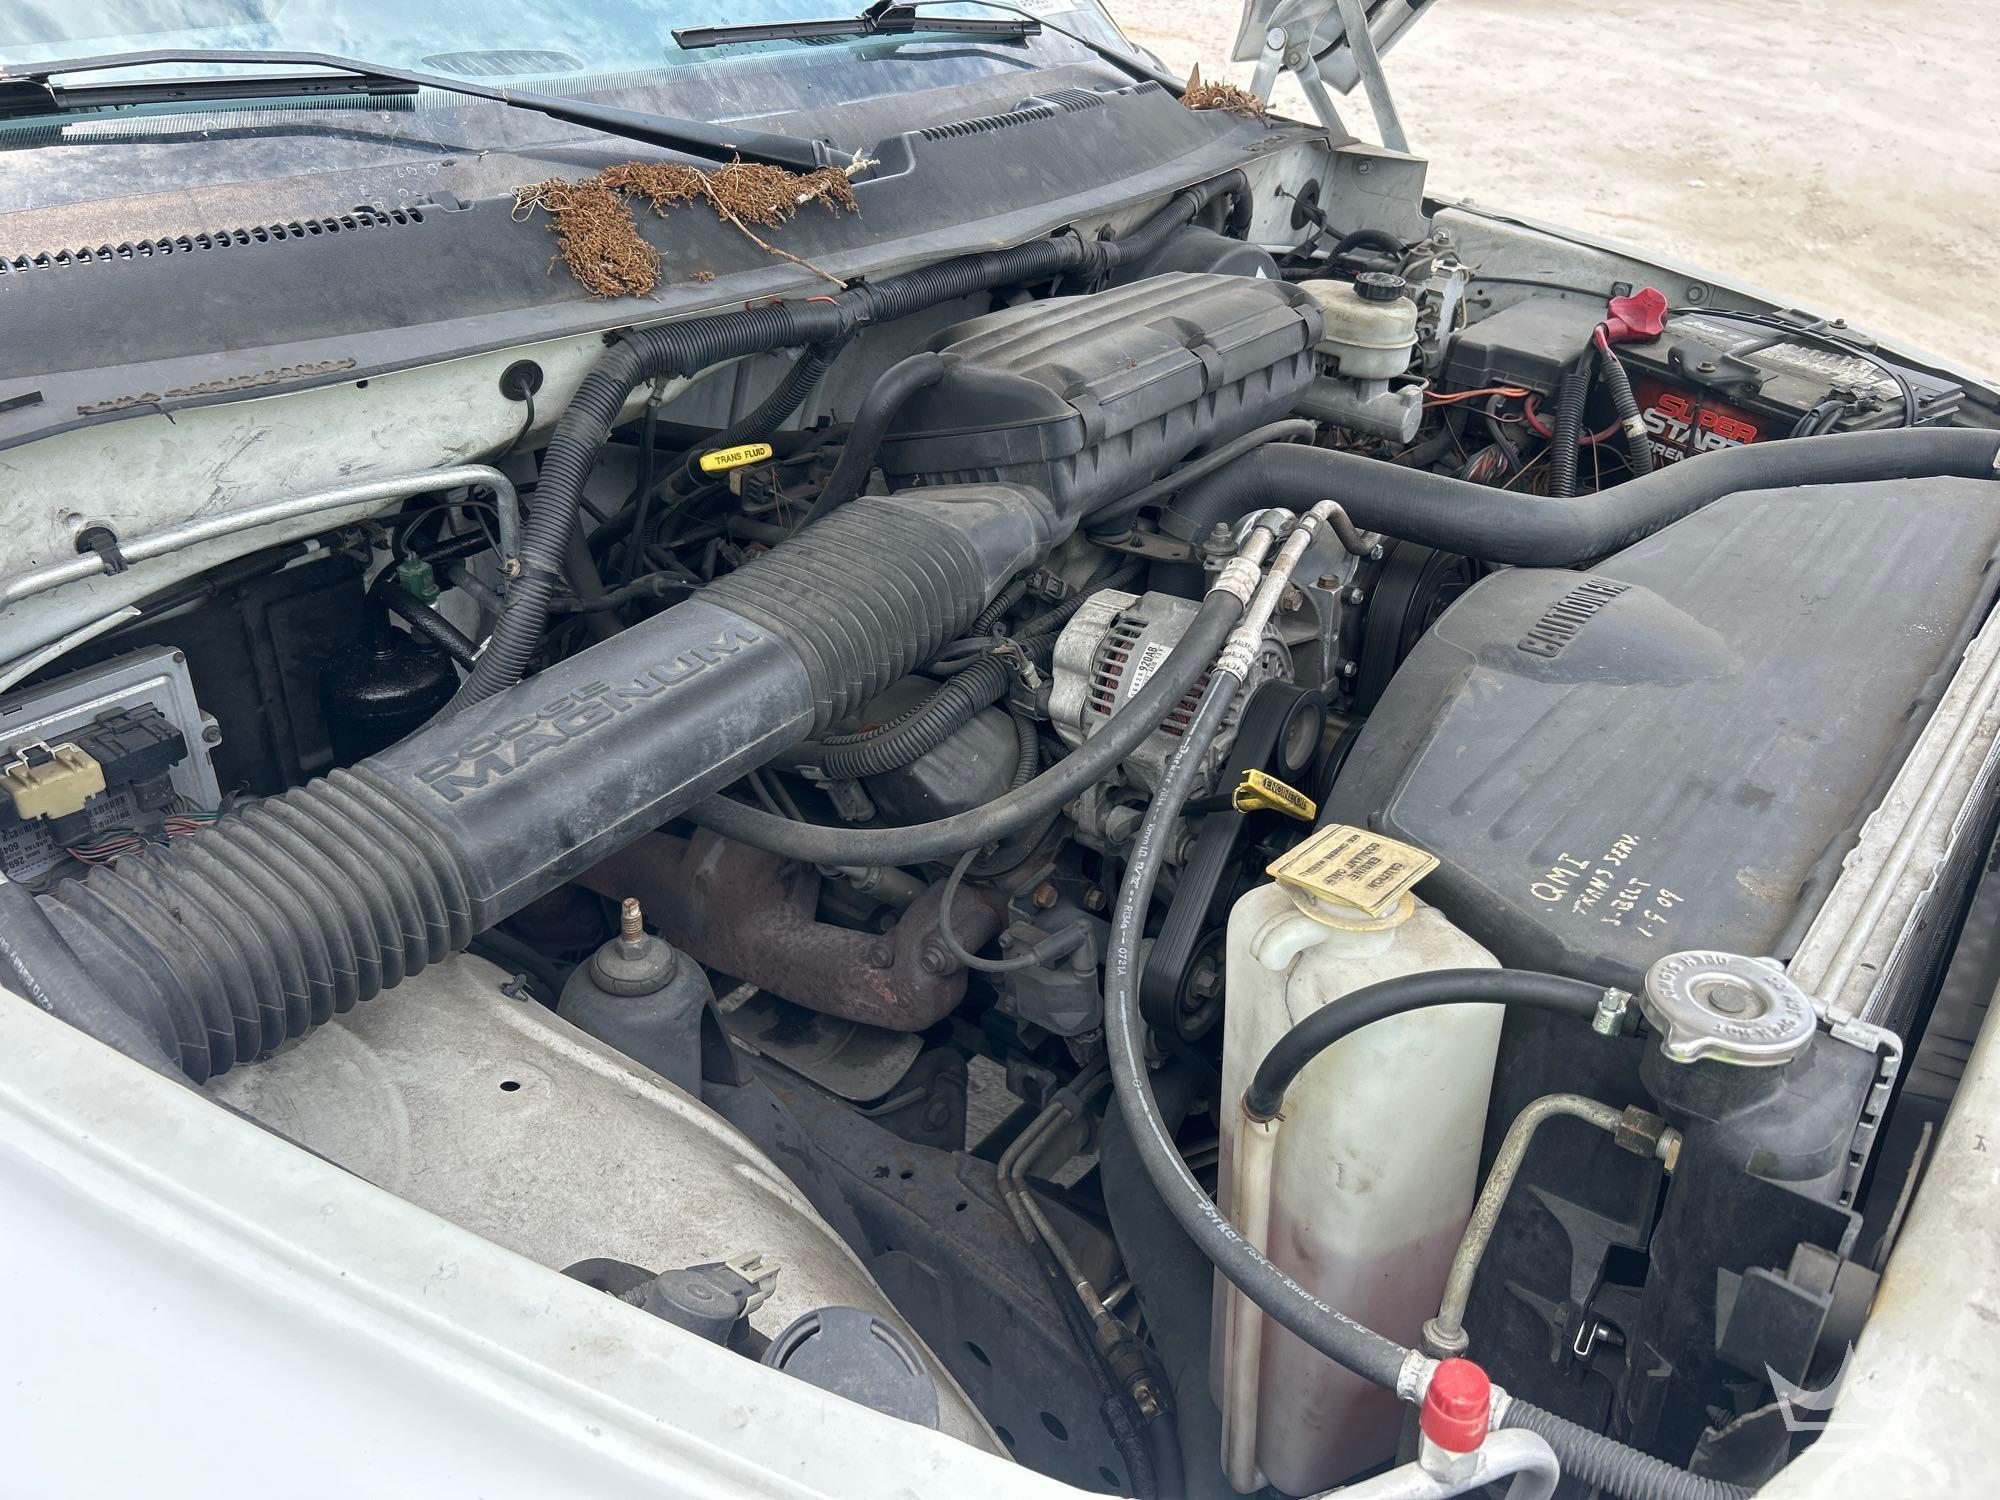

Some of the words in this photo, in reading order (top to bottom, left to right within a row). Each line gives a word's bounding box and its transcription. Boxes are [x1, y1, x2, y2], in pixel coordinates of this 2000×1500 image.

[1643, 407, 1744, 452] STAR
[1655, 393, 1757, 445] SUPER
[715, 452, 742, 465] TRANS
[744, 447, 766, 459] FLUID
[1517, 591, 1609, 658] CAUTION
[1138, 646, 1157, 671] 920AB
[414, 680, 612, 785] DODGE
[431, 627, 764, 802] MAGNUM
[1264, 778, 1296, 802] ENGINE
[1323, 868, 1347, 887] ONLY
[1347, 842, 1381, 870] COOLANT
[1349, 856, 1384, 882] ENGINE
[1530, 852, 1591, 902] QMI
[1572, 868, 1615, 915] TRANS
[1197, 1201, 1243, 1242] Parker
